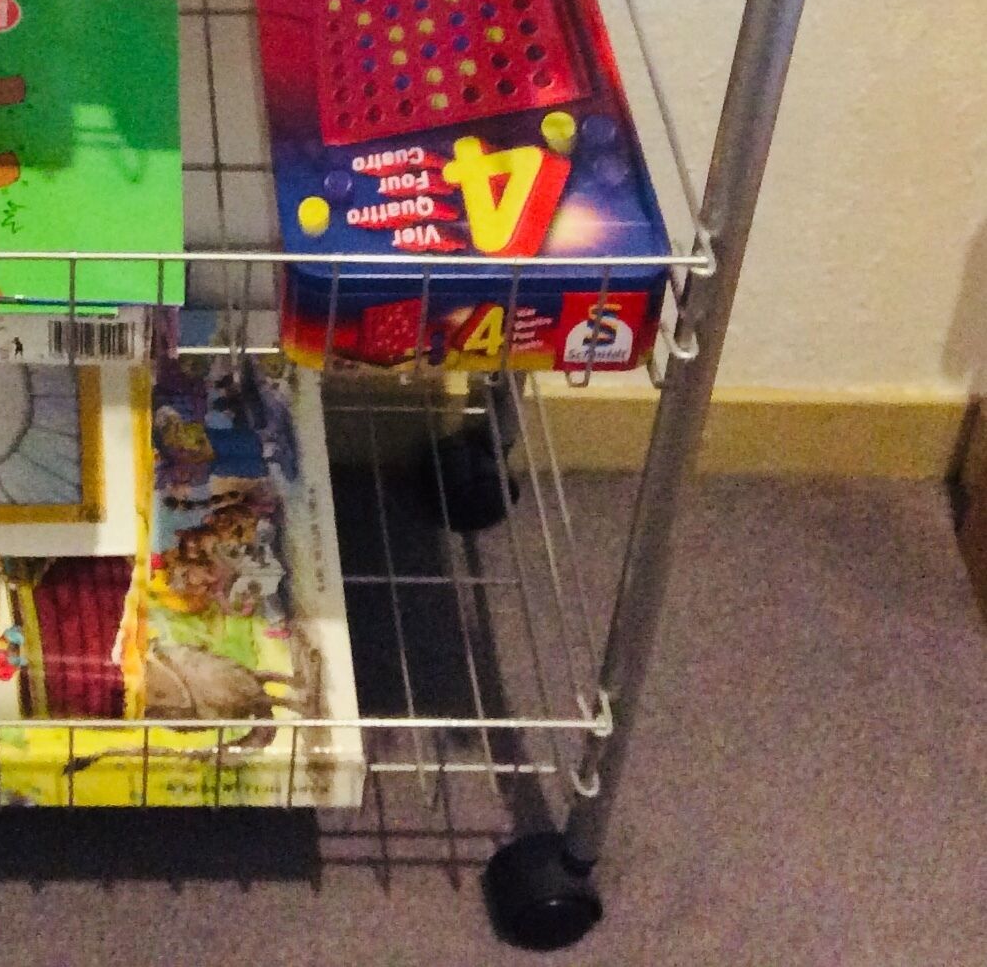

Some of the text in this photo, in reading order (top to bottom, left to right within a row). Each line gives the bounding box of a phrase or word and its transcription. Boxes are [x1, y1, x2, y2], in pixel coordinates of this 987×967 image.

[351, 146, 425, 172] Cuatro
[378, 170, 430, 194] Four
[442, 136, 555, 254] 4
[346, 196, 434, 224] Quattro
[392, 223, 441, 247] Vier
[464, 304, 505, 356] 4
